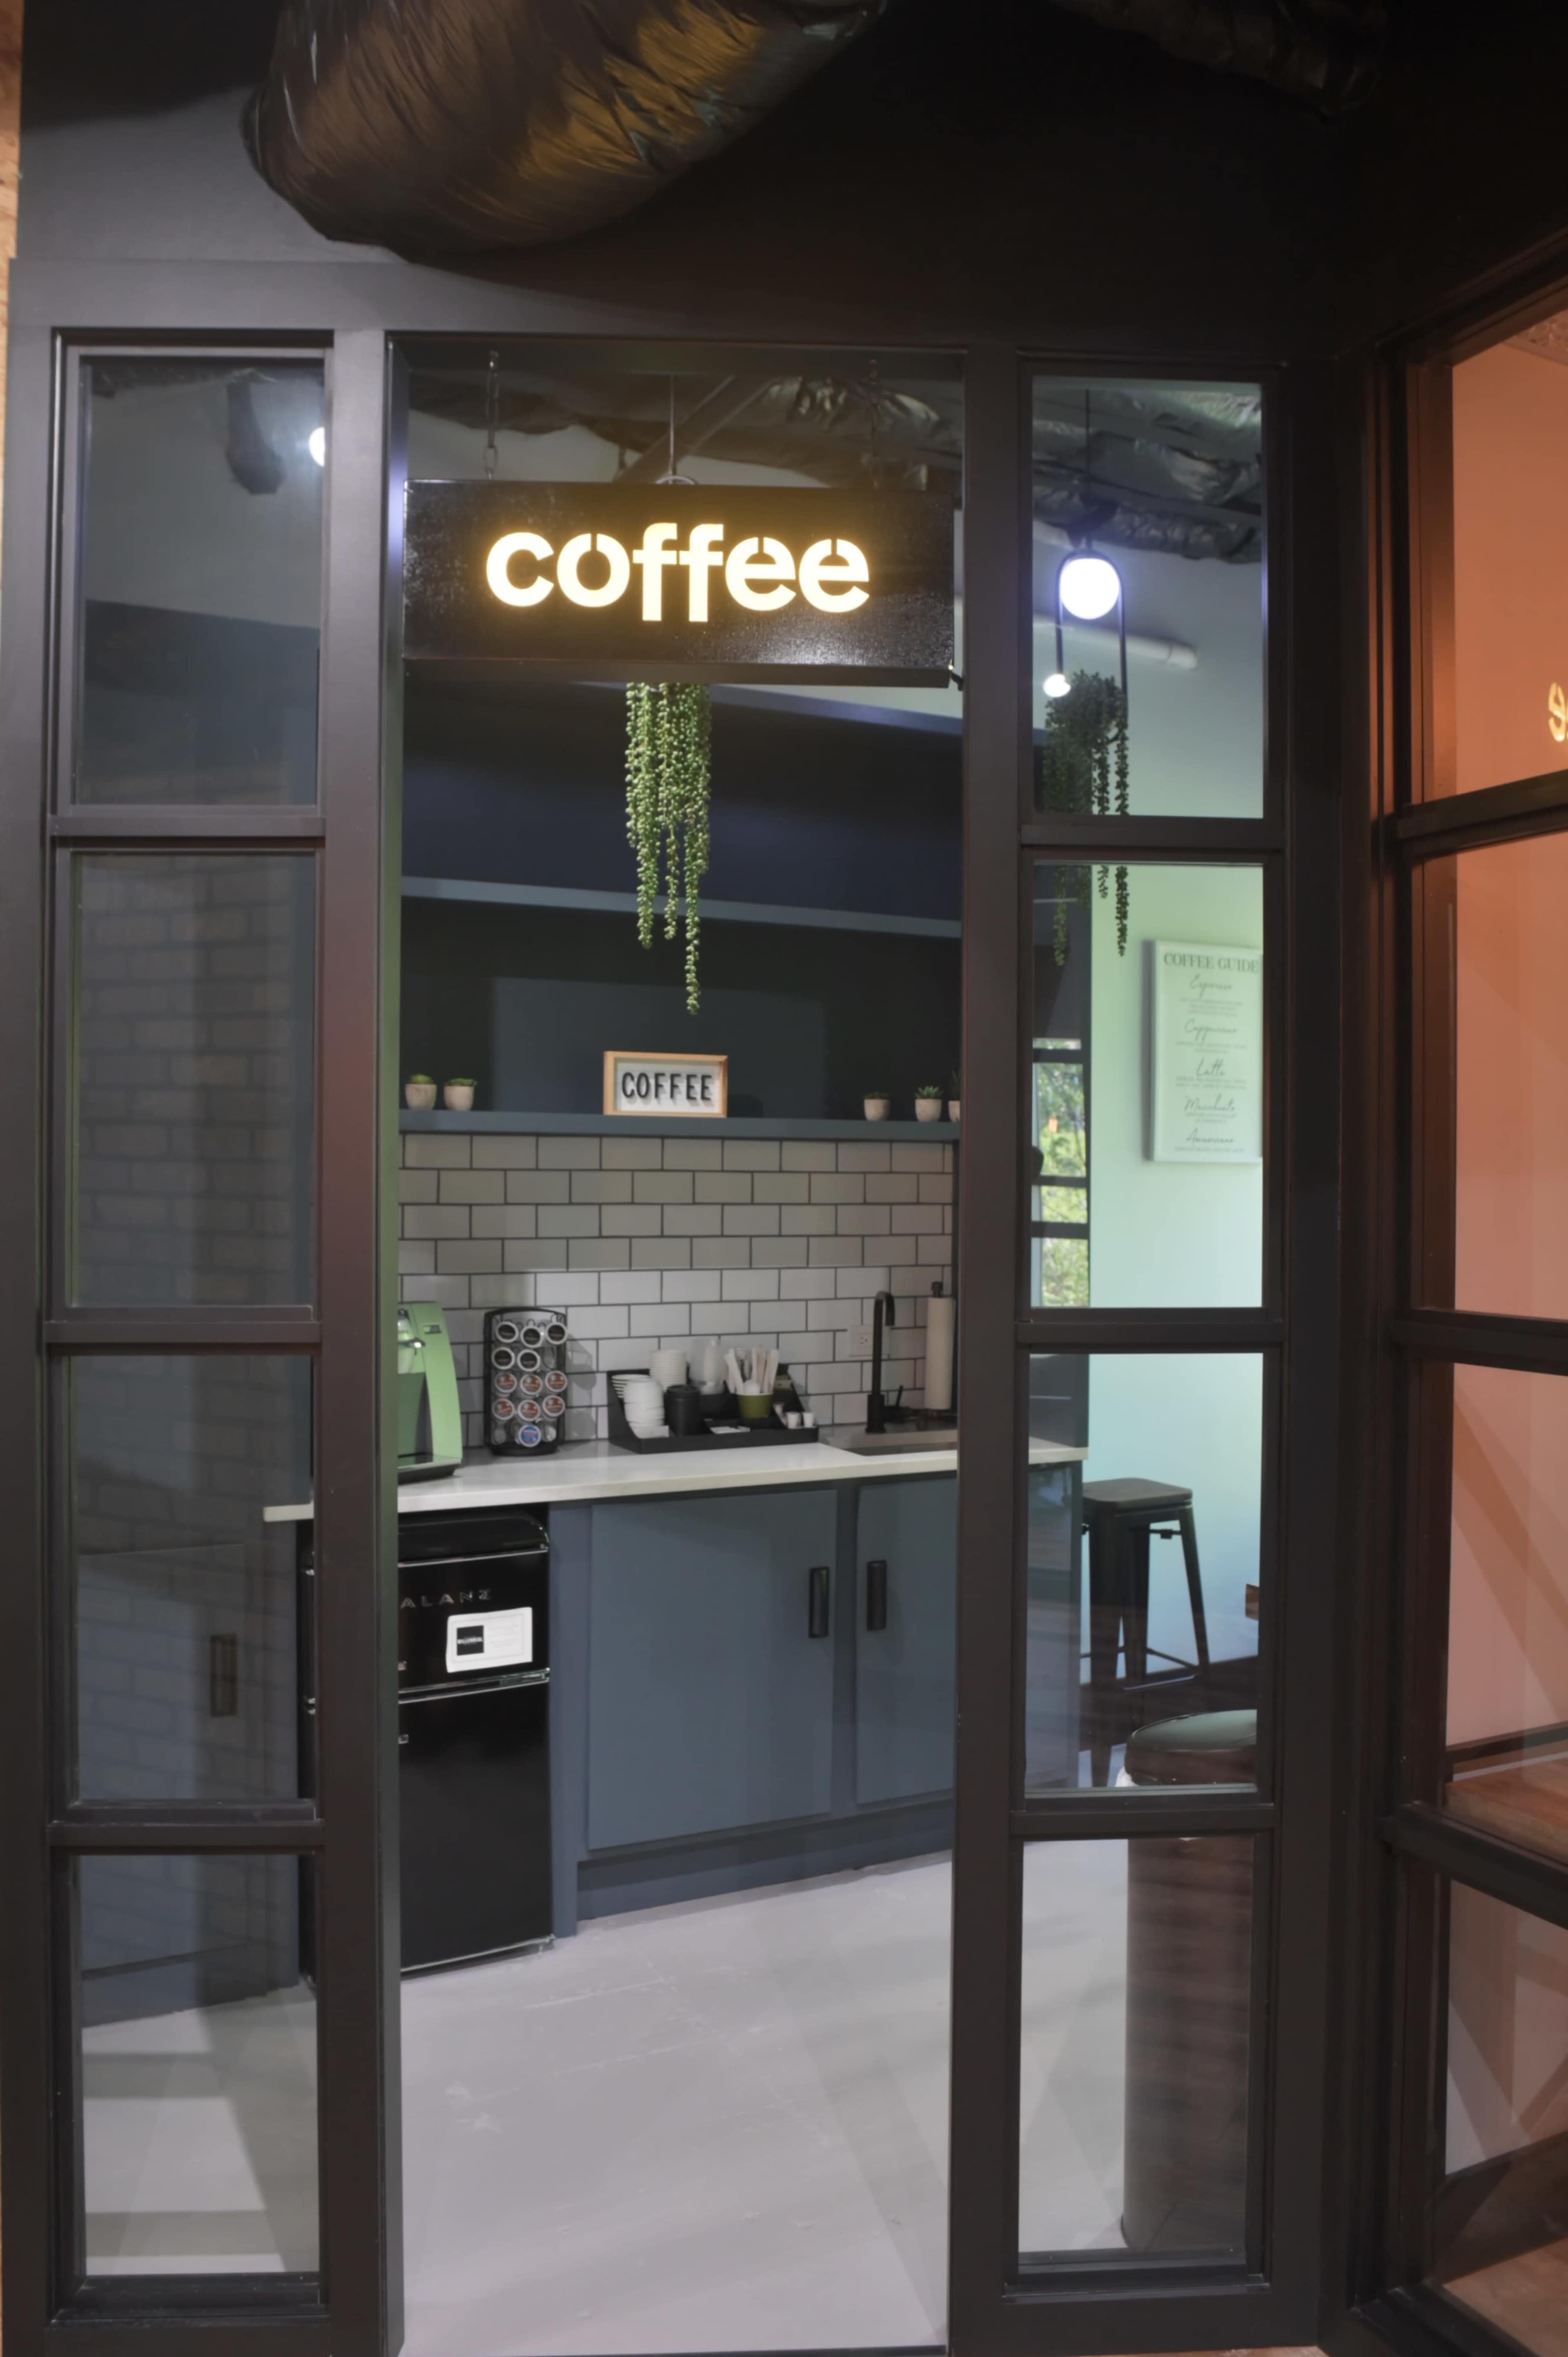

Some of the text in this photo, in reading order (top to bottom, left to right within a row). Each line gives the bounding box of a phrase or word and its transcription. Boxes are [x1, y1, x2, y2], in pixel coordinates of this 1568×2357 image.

[486, 522, 870, 623] coffee
[1163, 952, 1259, 974] COFFEE GUIDE
[621, 1072, 712, 1101] COFFEE
[400, 1588, 491, 1609] ALANZ
